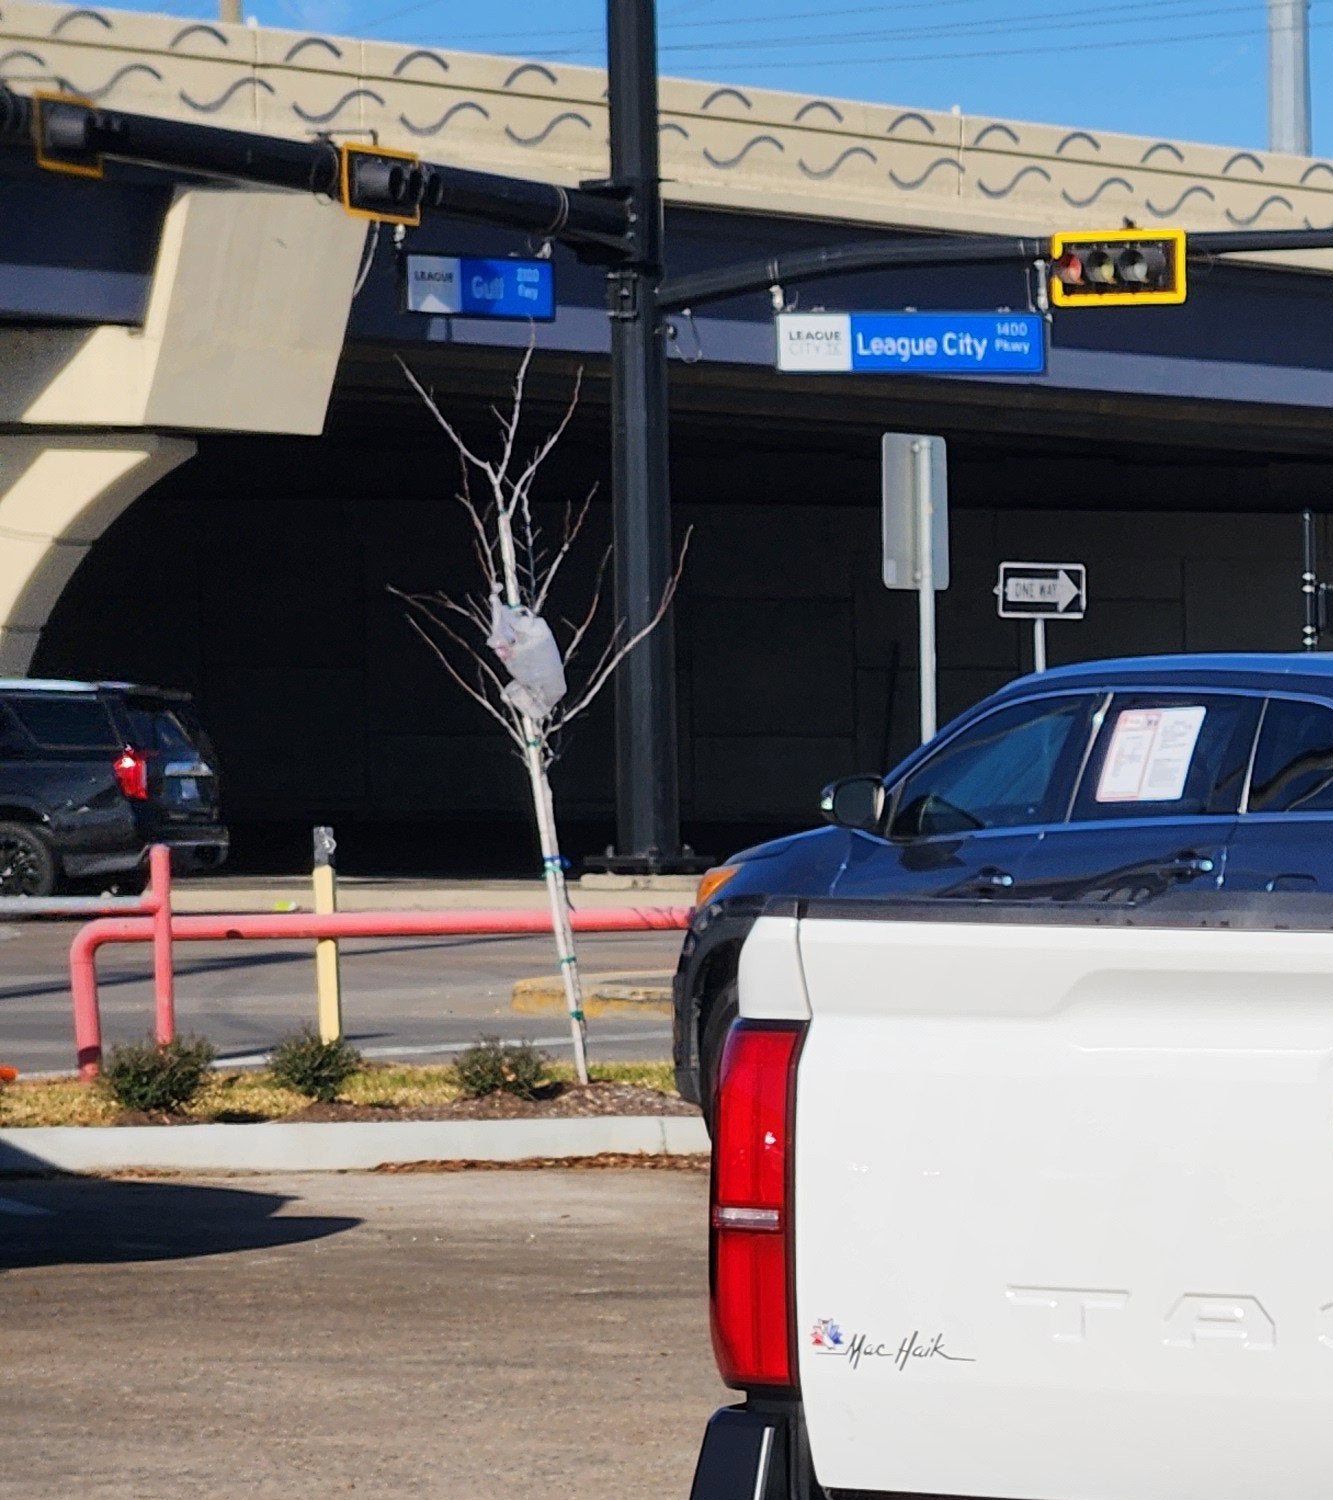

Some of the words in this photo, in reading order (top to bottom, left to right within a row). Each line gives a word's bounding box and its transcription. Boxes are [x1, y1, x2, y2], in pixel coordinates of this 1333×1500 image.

[788, 331, 842, 341] LEAGUE
[996, 322, 1028, 337] 1400
[856, 332, 939, 362] League
[942, 331, 988, 361] City
[995, 339, 1030, 355] Pkwy
[848, 1333, 894, 1370] Mac
[894, 1331, 962, 1371] Haik
